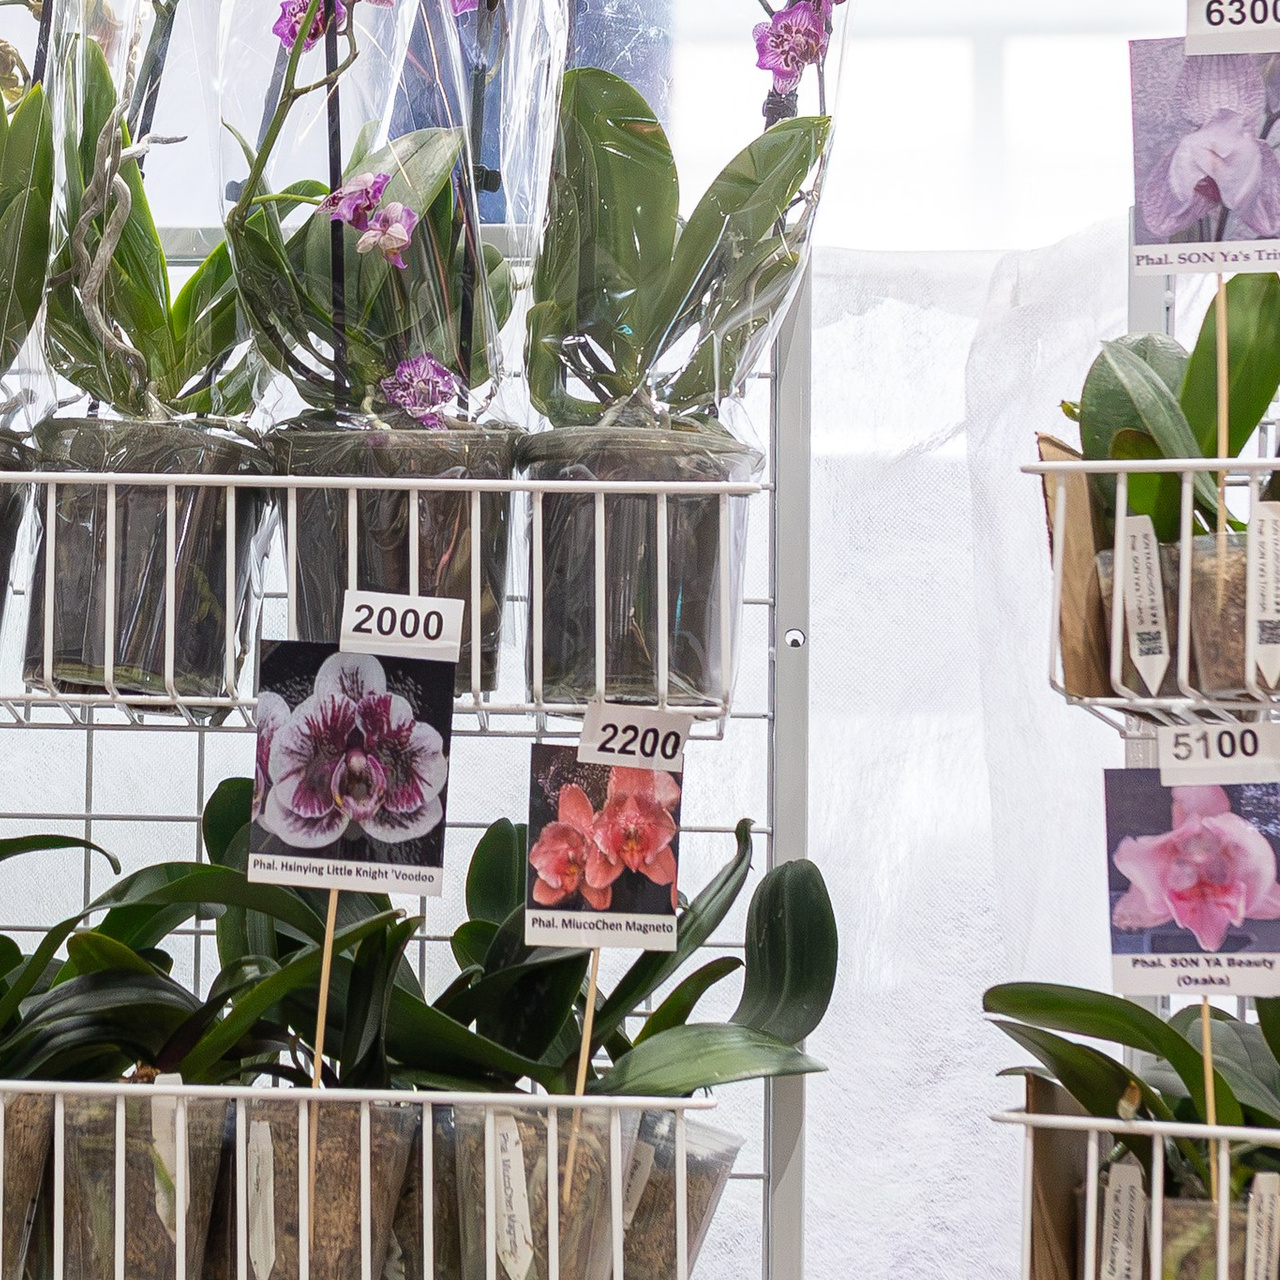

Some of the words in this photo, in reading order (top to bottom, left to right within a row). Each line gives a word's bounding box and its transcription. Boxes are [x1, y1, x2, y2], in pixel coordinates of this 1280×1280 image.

[1178, 252, 1215, 264] SON
[352, 604, 444, 641] 2000
[597, 723, 681, 760] 2200
[1172, 728, 1259, 761] 5100
[253, 858, 278, 871] Phal.
[281, 862, 324, 876] Hsinying
[327, 864, 353, 877] Little
[355, 866, 388, 880] Knight
[531, 917, 558, 929] Phal.
[625, 921, 674, 934] Magneto
[1170, 957, 1199, 968] SON
[1227, 957, 1276, 970] Beauty
[1177, 974, 1230, 987] (Osaka)
